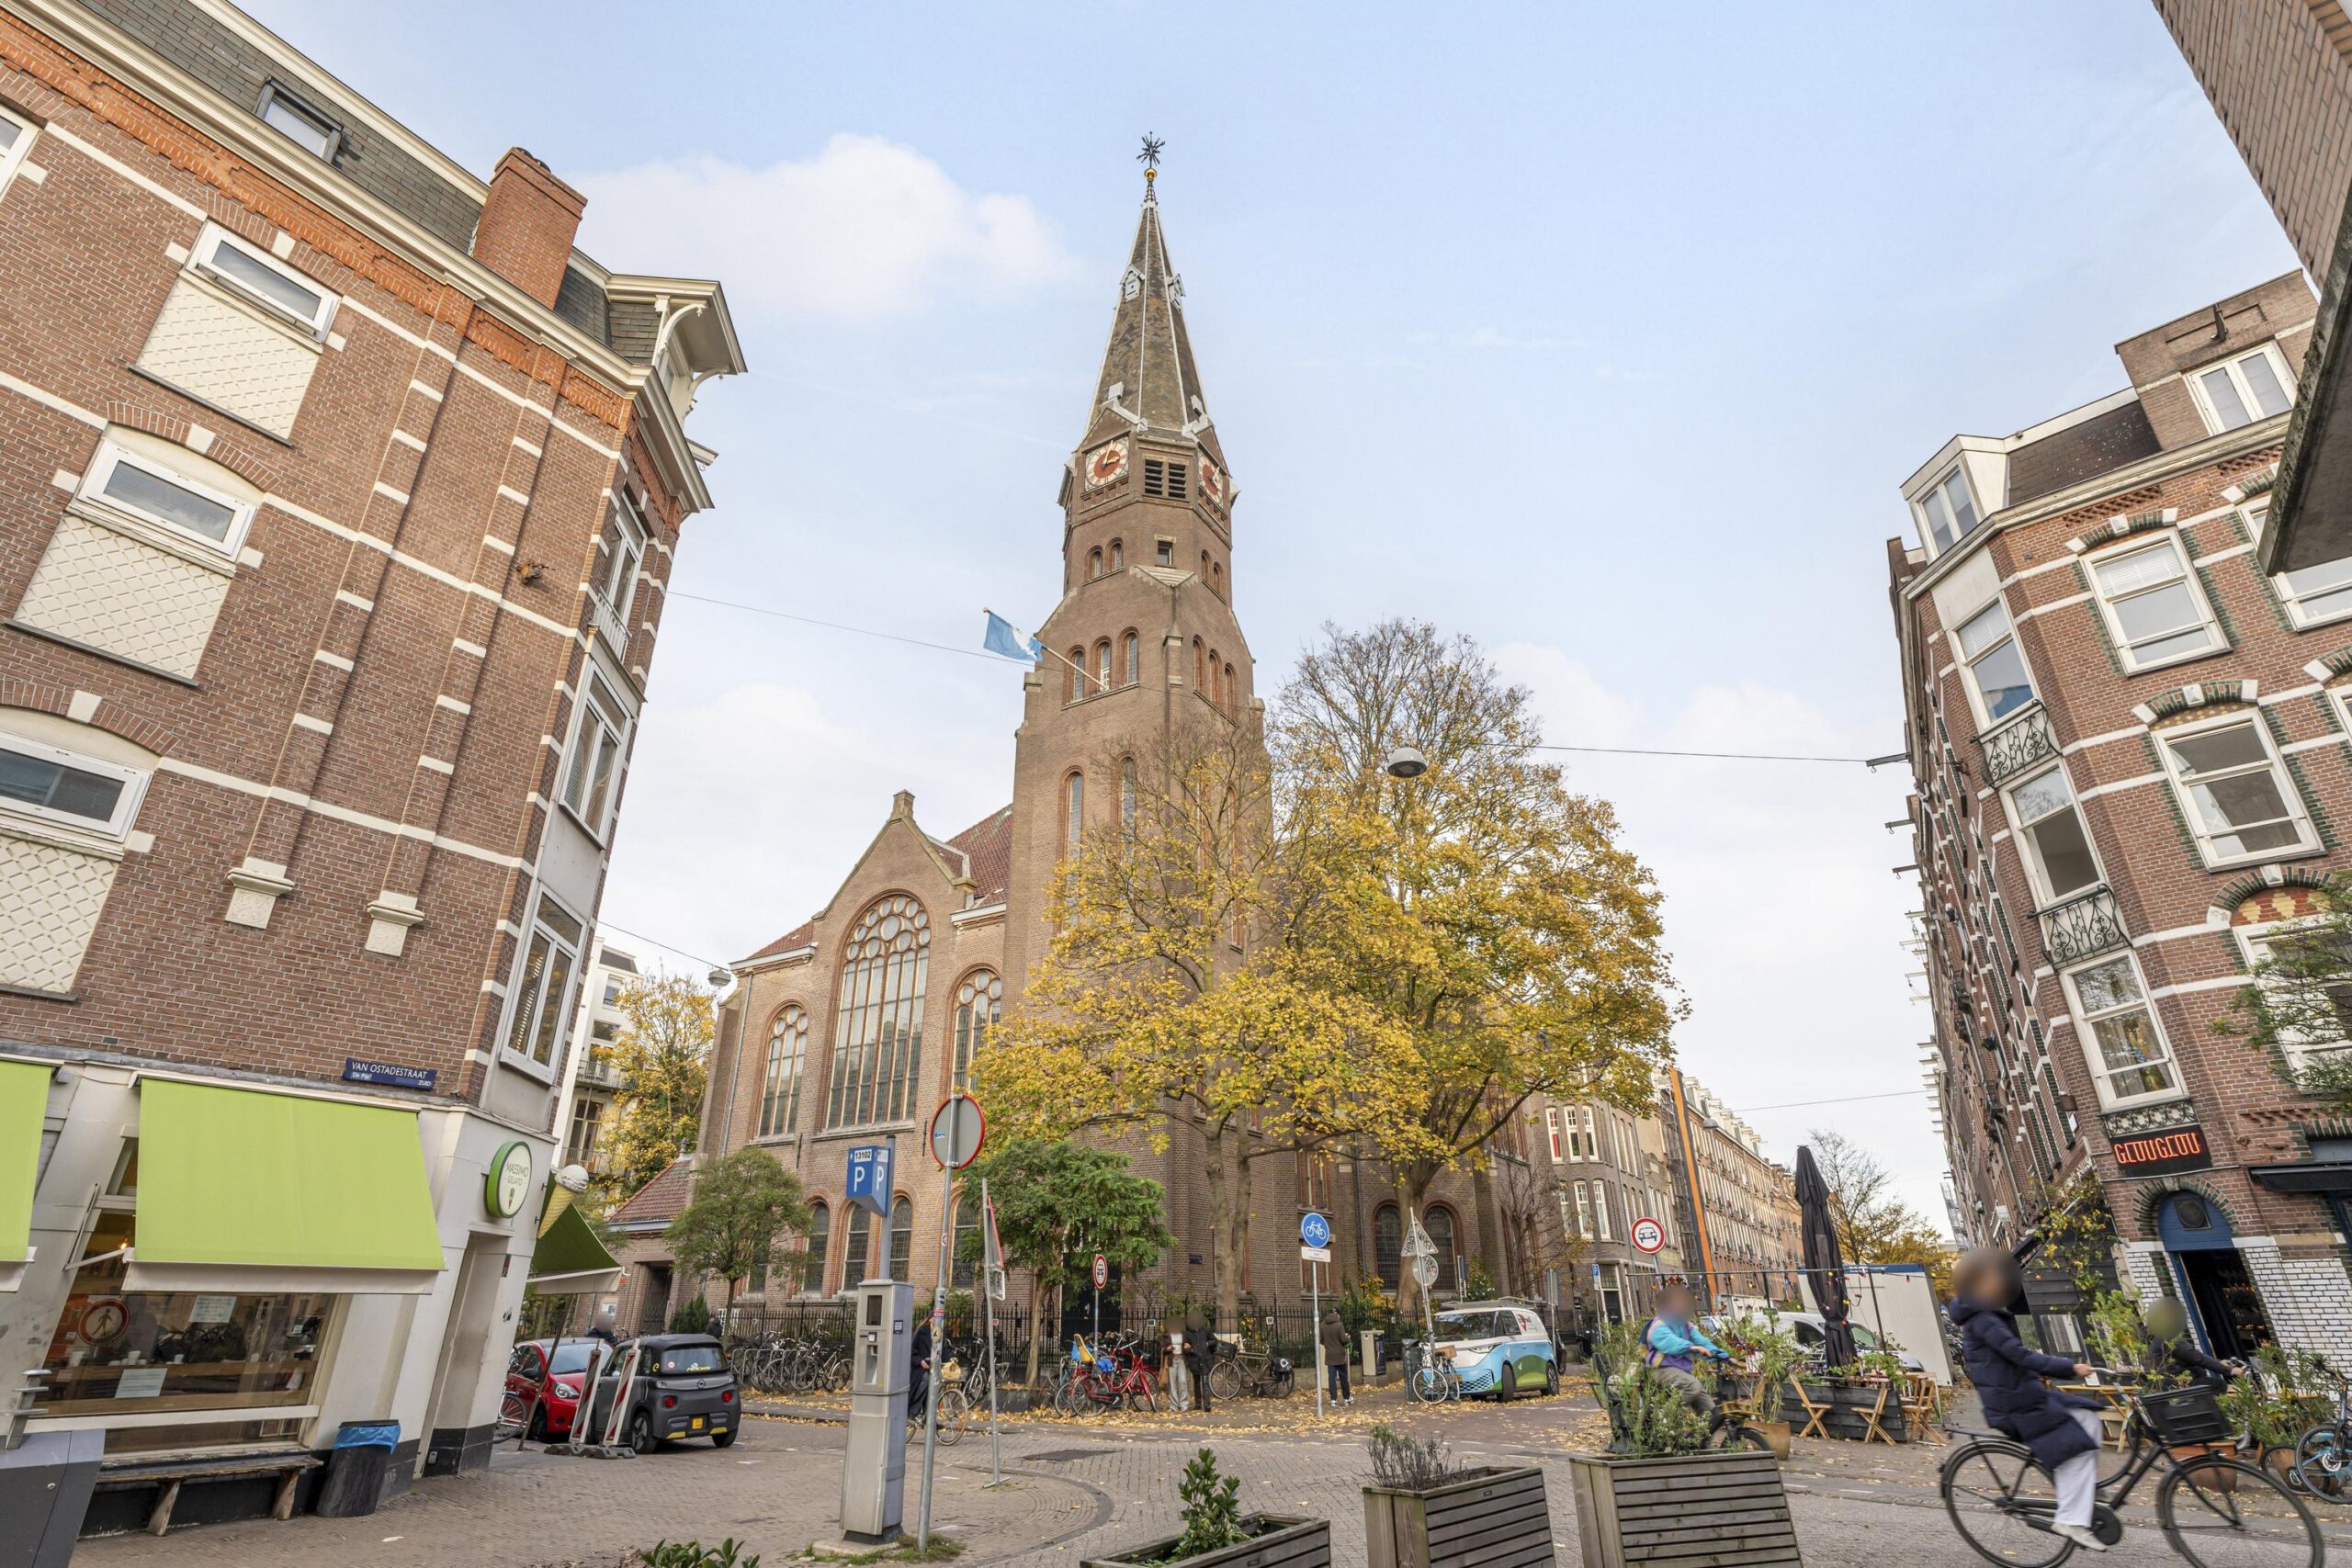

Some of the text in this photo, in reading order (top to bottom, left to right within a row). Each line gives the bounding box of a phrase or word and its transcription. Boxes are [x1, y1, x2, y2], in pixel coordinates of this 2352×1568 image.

[352, 1061, 427, 1079] VAN OSTADESTRAAT
[854, 1150, 871, 1160] 13102
[506, 1161, 529, 1178] MASSIMO
[507, 1175, 523, 1187] GELATO
[854, 1166, 865, 1192] P
[876, 1166, 885, 1191] P
